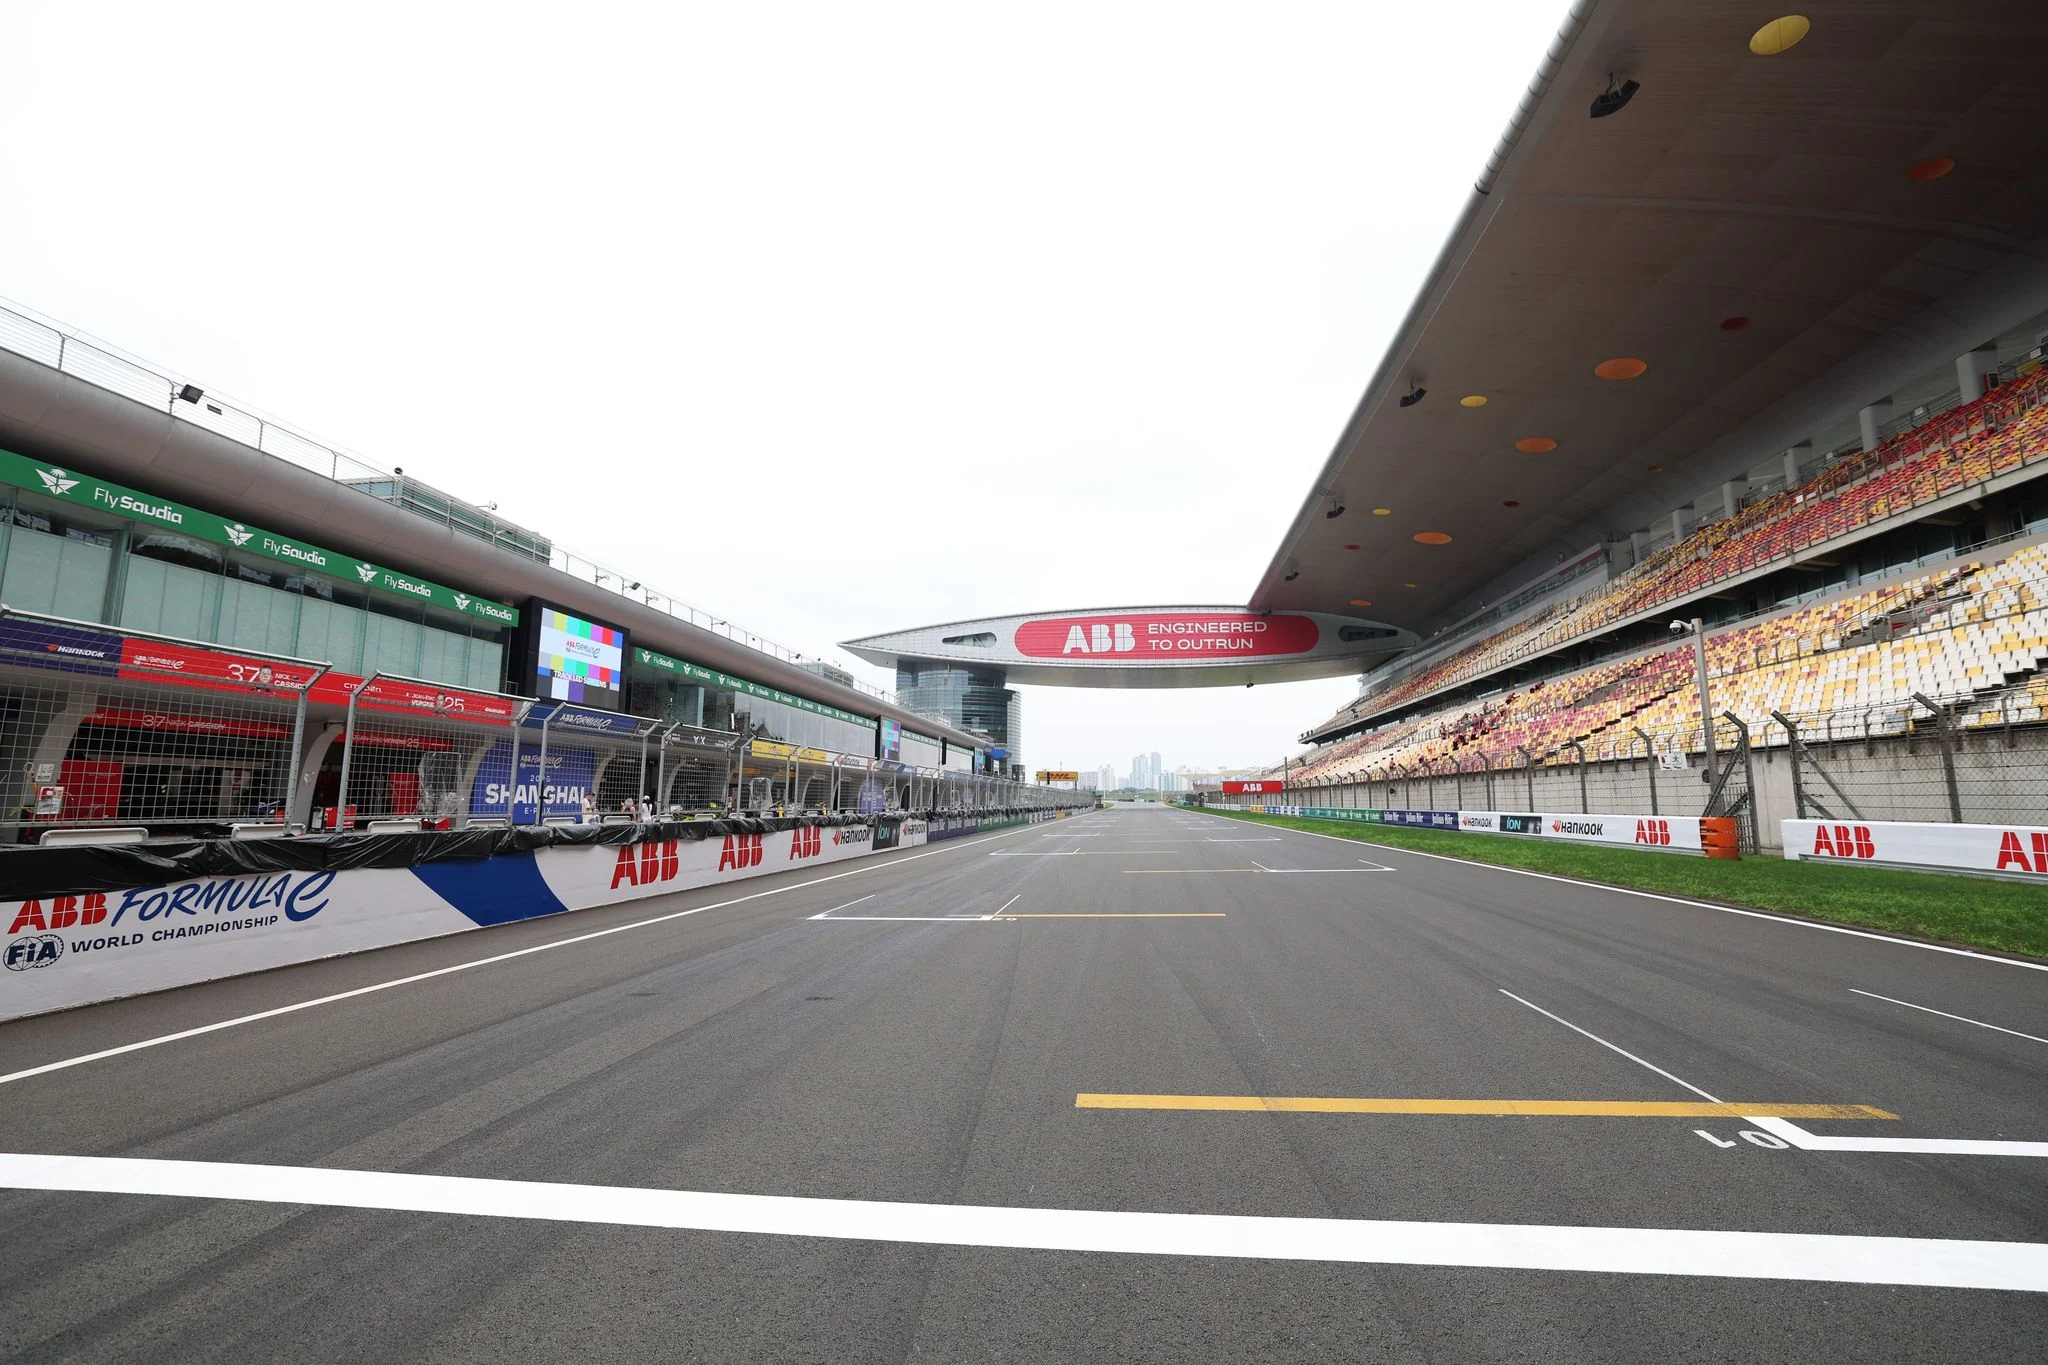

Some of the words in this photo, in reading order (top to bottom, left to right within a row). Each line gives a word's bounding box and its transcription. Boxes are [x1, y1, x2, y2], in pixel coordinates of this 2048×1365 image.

[1147, 621, 1268, 634] ENGINEERED
[1062, 623, 1136, 655] ABB
[1148, 639, 1173, 651] TO
[1177, 638, 1254, 651] OUTRUN
[227, 663, 260, 683] 37
[273, 673, 291, 681] NICK
[554, 670, 573, 681] TRACK
[572, 674, 584, 683] LED
[274, 680, 305, 690] CASSID
[444, 696, 465, 712] 25
[143, 714, 166, 728] 37
[406, 738, 420, 748] 25
[1242, 783, 1263, 792] ABB
[524, 807, 552, 815] E-PIX
[1635, 819, 1671, 846] ABB
[789, 825, 821, 861] ABB
[1814, 824, 1875, 859] ABB
[718, 833, 763, 872] ABB
[610, 838, 679, 890] ABB
[8, 893, 108, 934] ABB
[71, 933, 144, 954] WORLD
[152, 915, 278, 943] CHAMPIONSHIP
